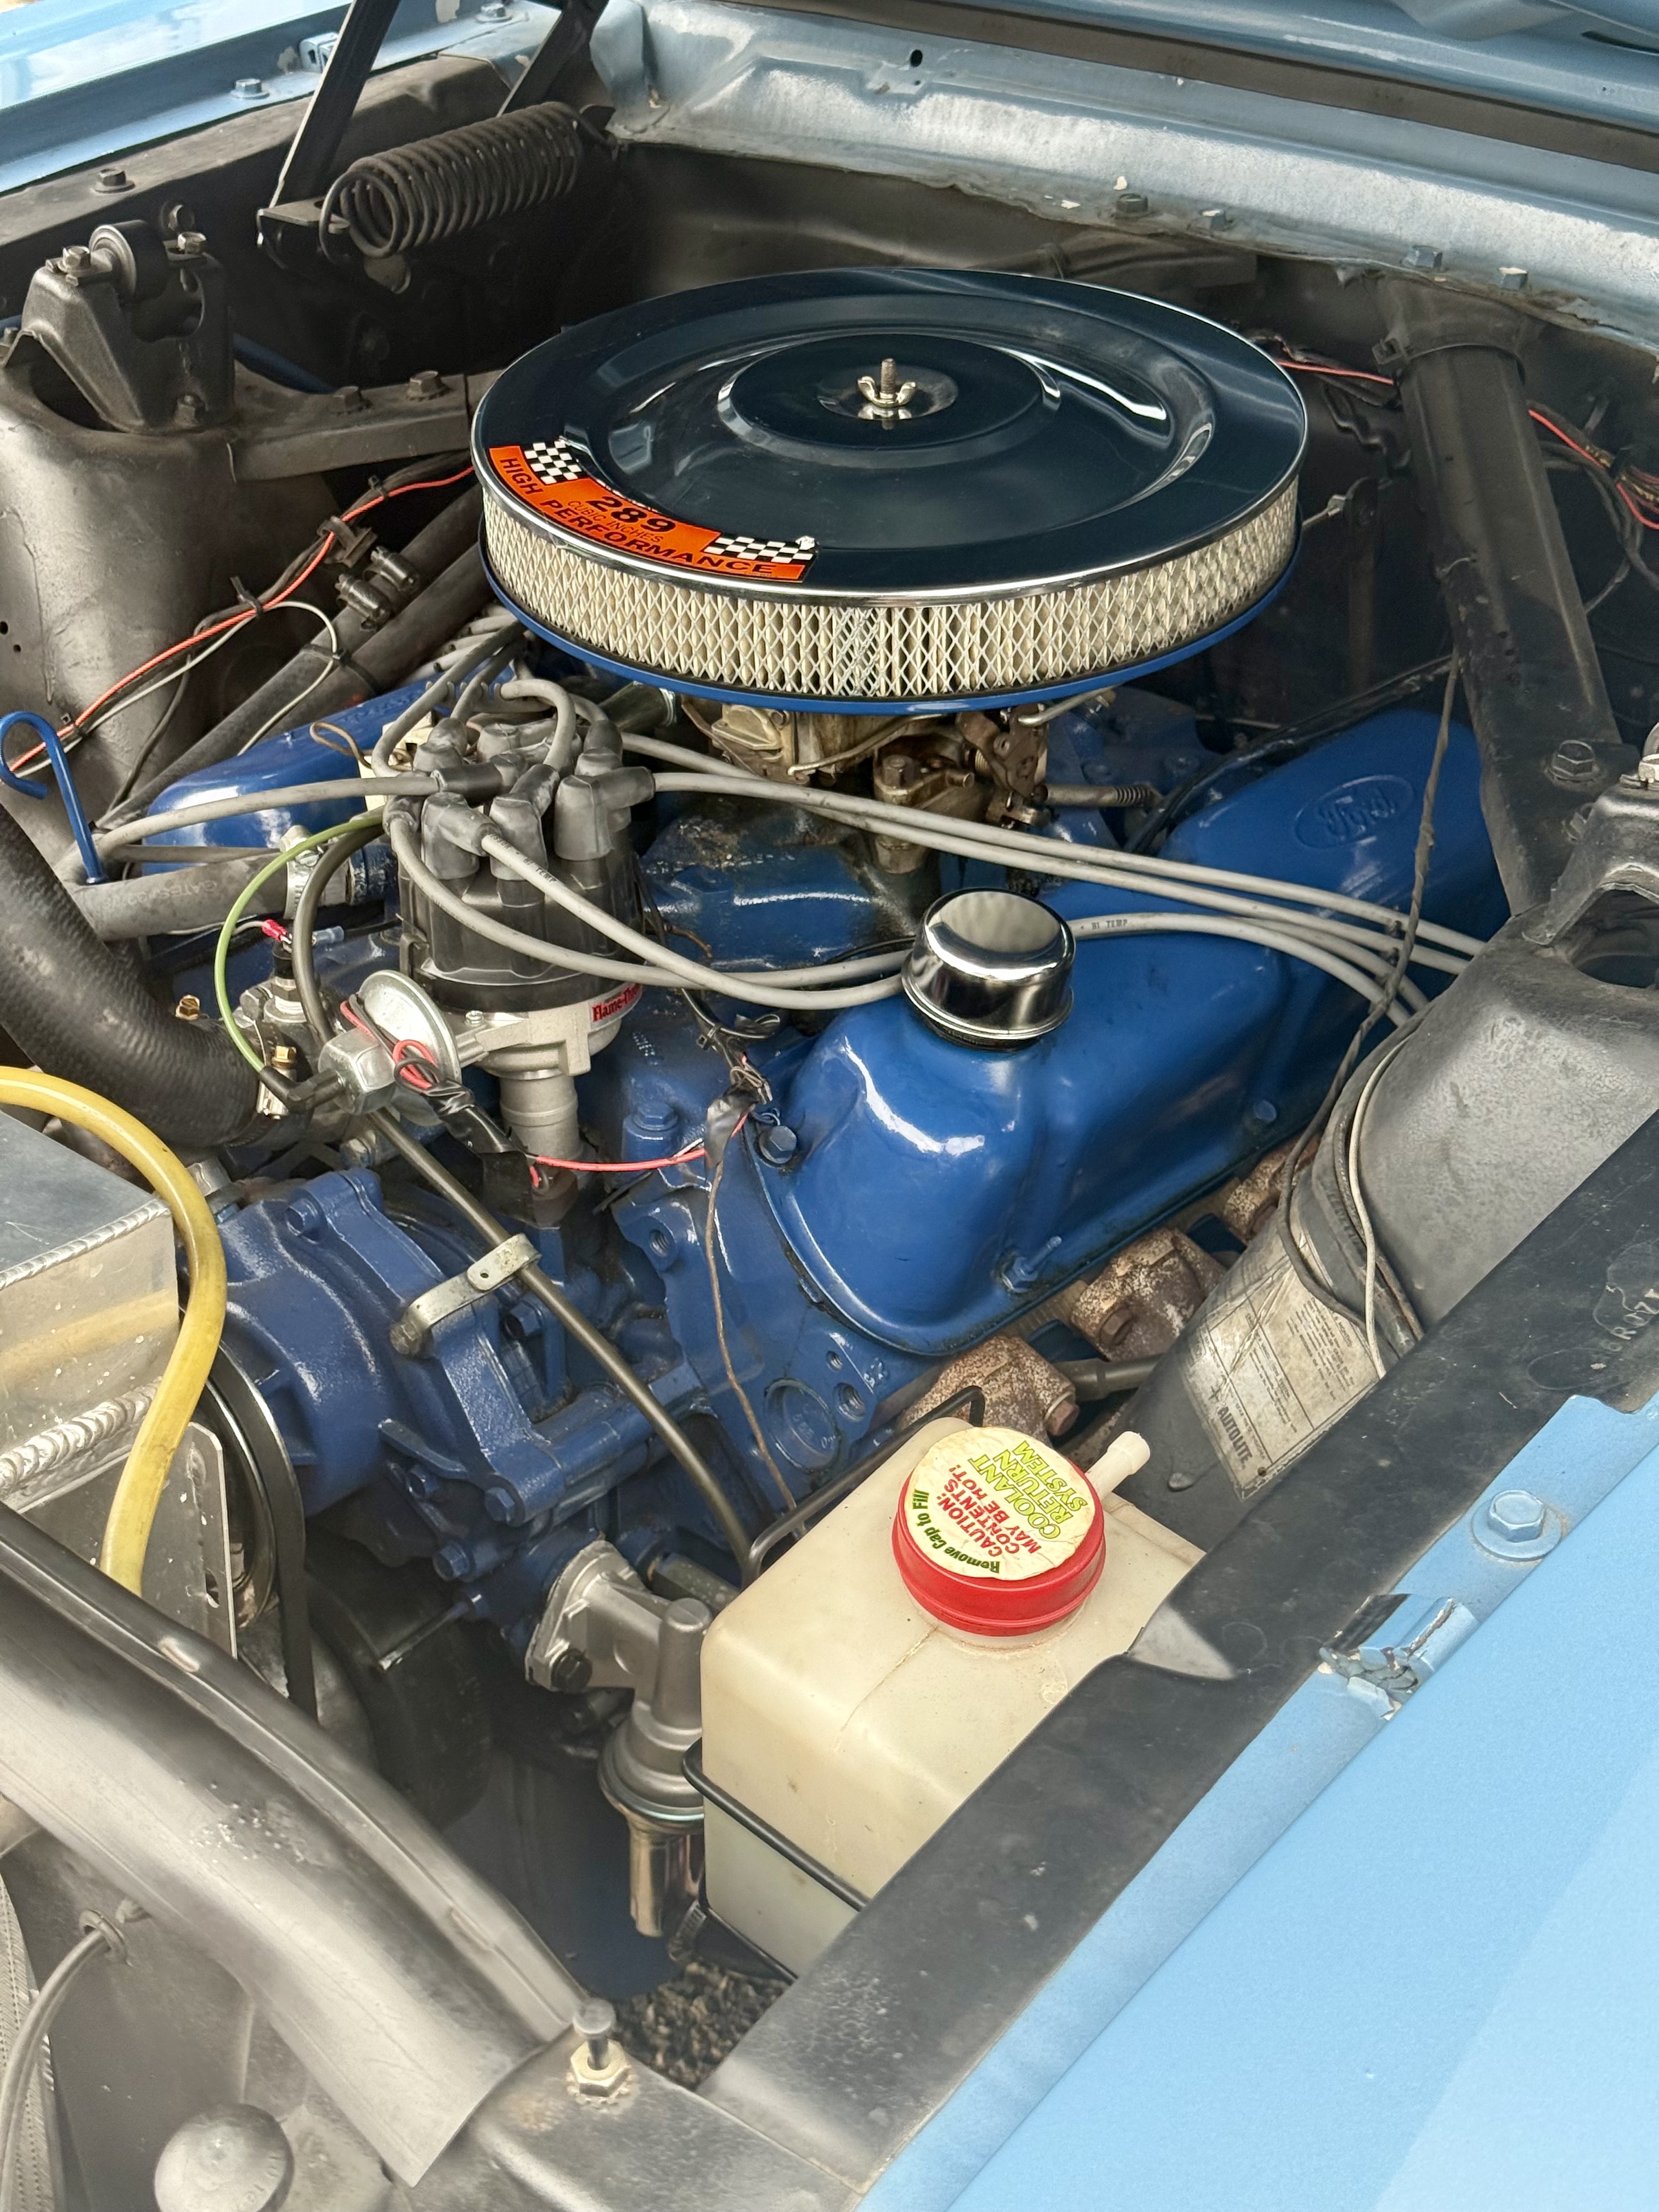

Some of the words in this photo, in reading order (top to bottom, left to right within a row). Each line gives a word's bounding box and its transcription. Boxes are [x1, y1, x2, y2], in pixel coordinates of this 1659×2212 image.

[499, 456, 544, 495] HIGH
[539, 499, 777, 575] PERFORMANCE
[567, 500, 607, 522] CUBIC
[606, 521, 664, 543] INCHES
[585, 495, 676, 533] 289
[535, 867, 558, 883] TEMP
[1216, 1406, 1254, 1465] AUTOLITE
[948, 1464, 988, 1498] HOT!
[992, 1449, 1074, 1524] RETURN
[1012, 1440, 1088, 1512] SYSTEM
[912, 1488, 930, 1510] Fill
[967, 1454, 1061, 1539] COOLANT
[984, 1500, 1010, 1524] BE
[915, 1513, 932, 1527] to
[944, 1479, 1020, 1554] CONTENTS
[924, 1526, 947, 1549] Cap
[1008, 1525, 1042, 1554] MAY
[944, 1546, 1000, 1575] Remove
